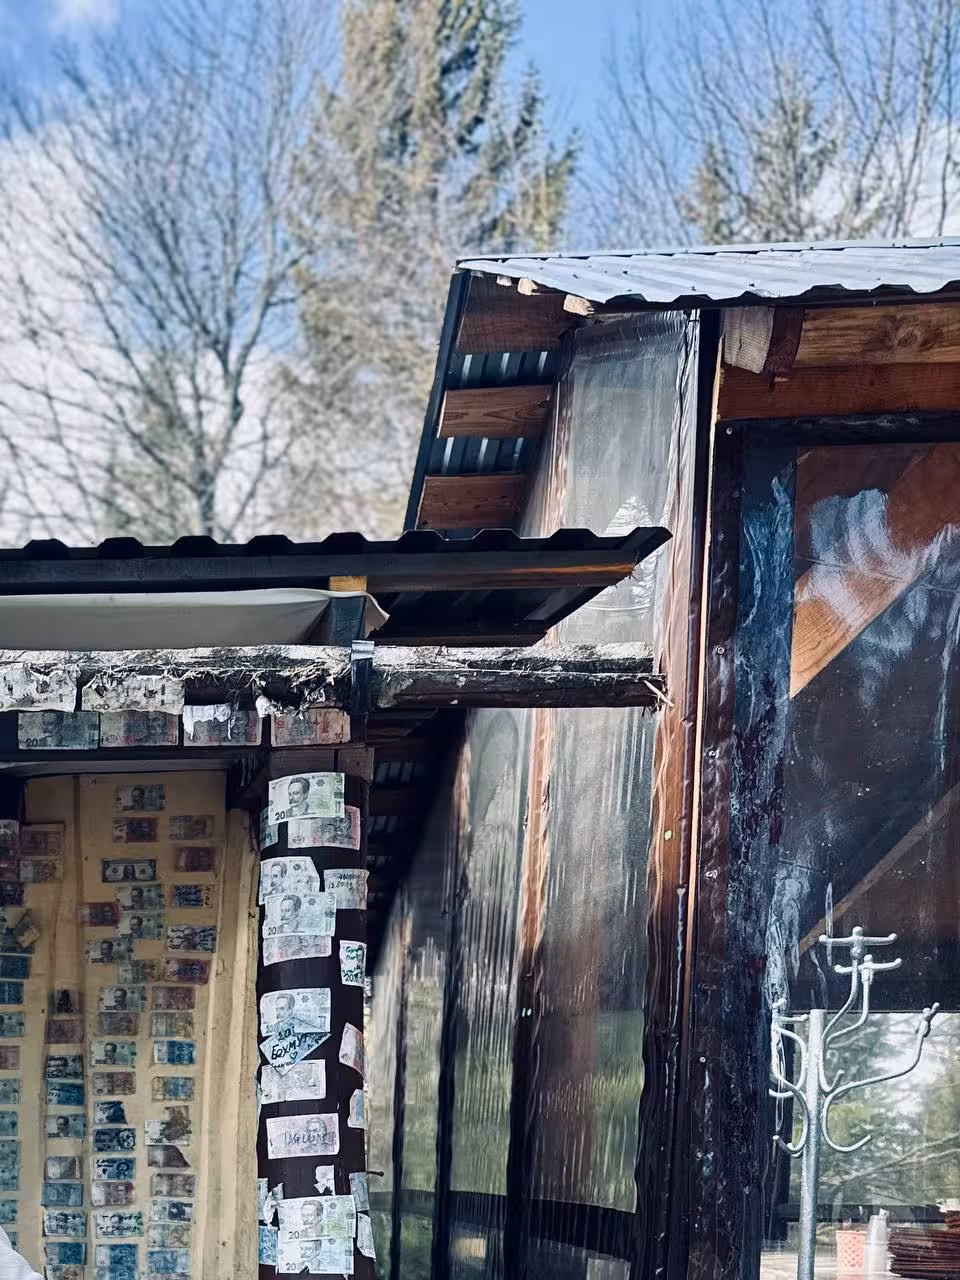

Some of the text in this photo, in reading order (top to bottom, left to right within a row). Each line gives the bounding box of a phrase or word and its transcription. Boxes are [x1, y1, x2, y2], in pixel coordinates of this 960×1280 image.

[25, 738, 38, 747] 20
[275, 811, 286, 821] 20
[288, 1231, 300, 1240] 20
